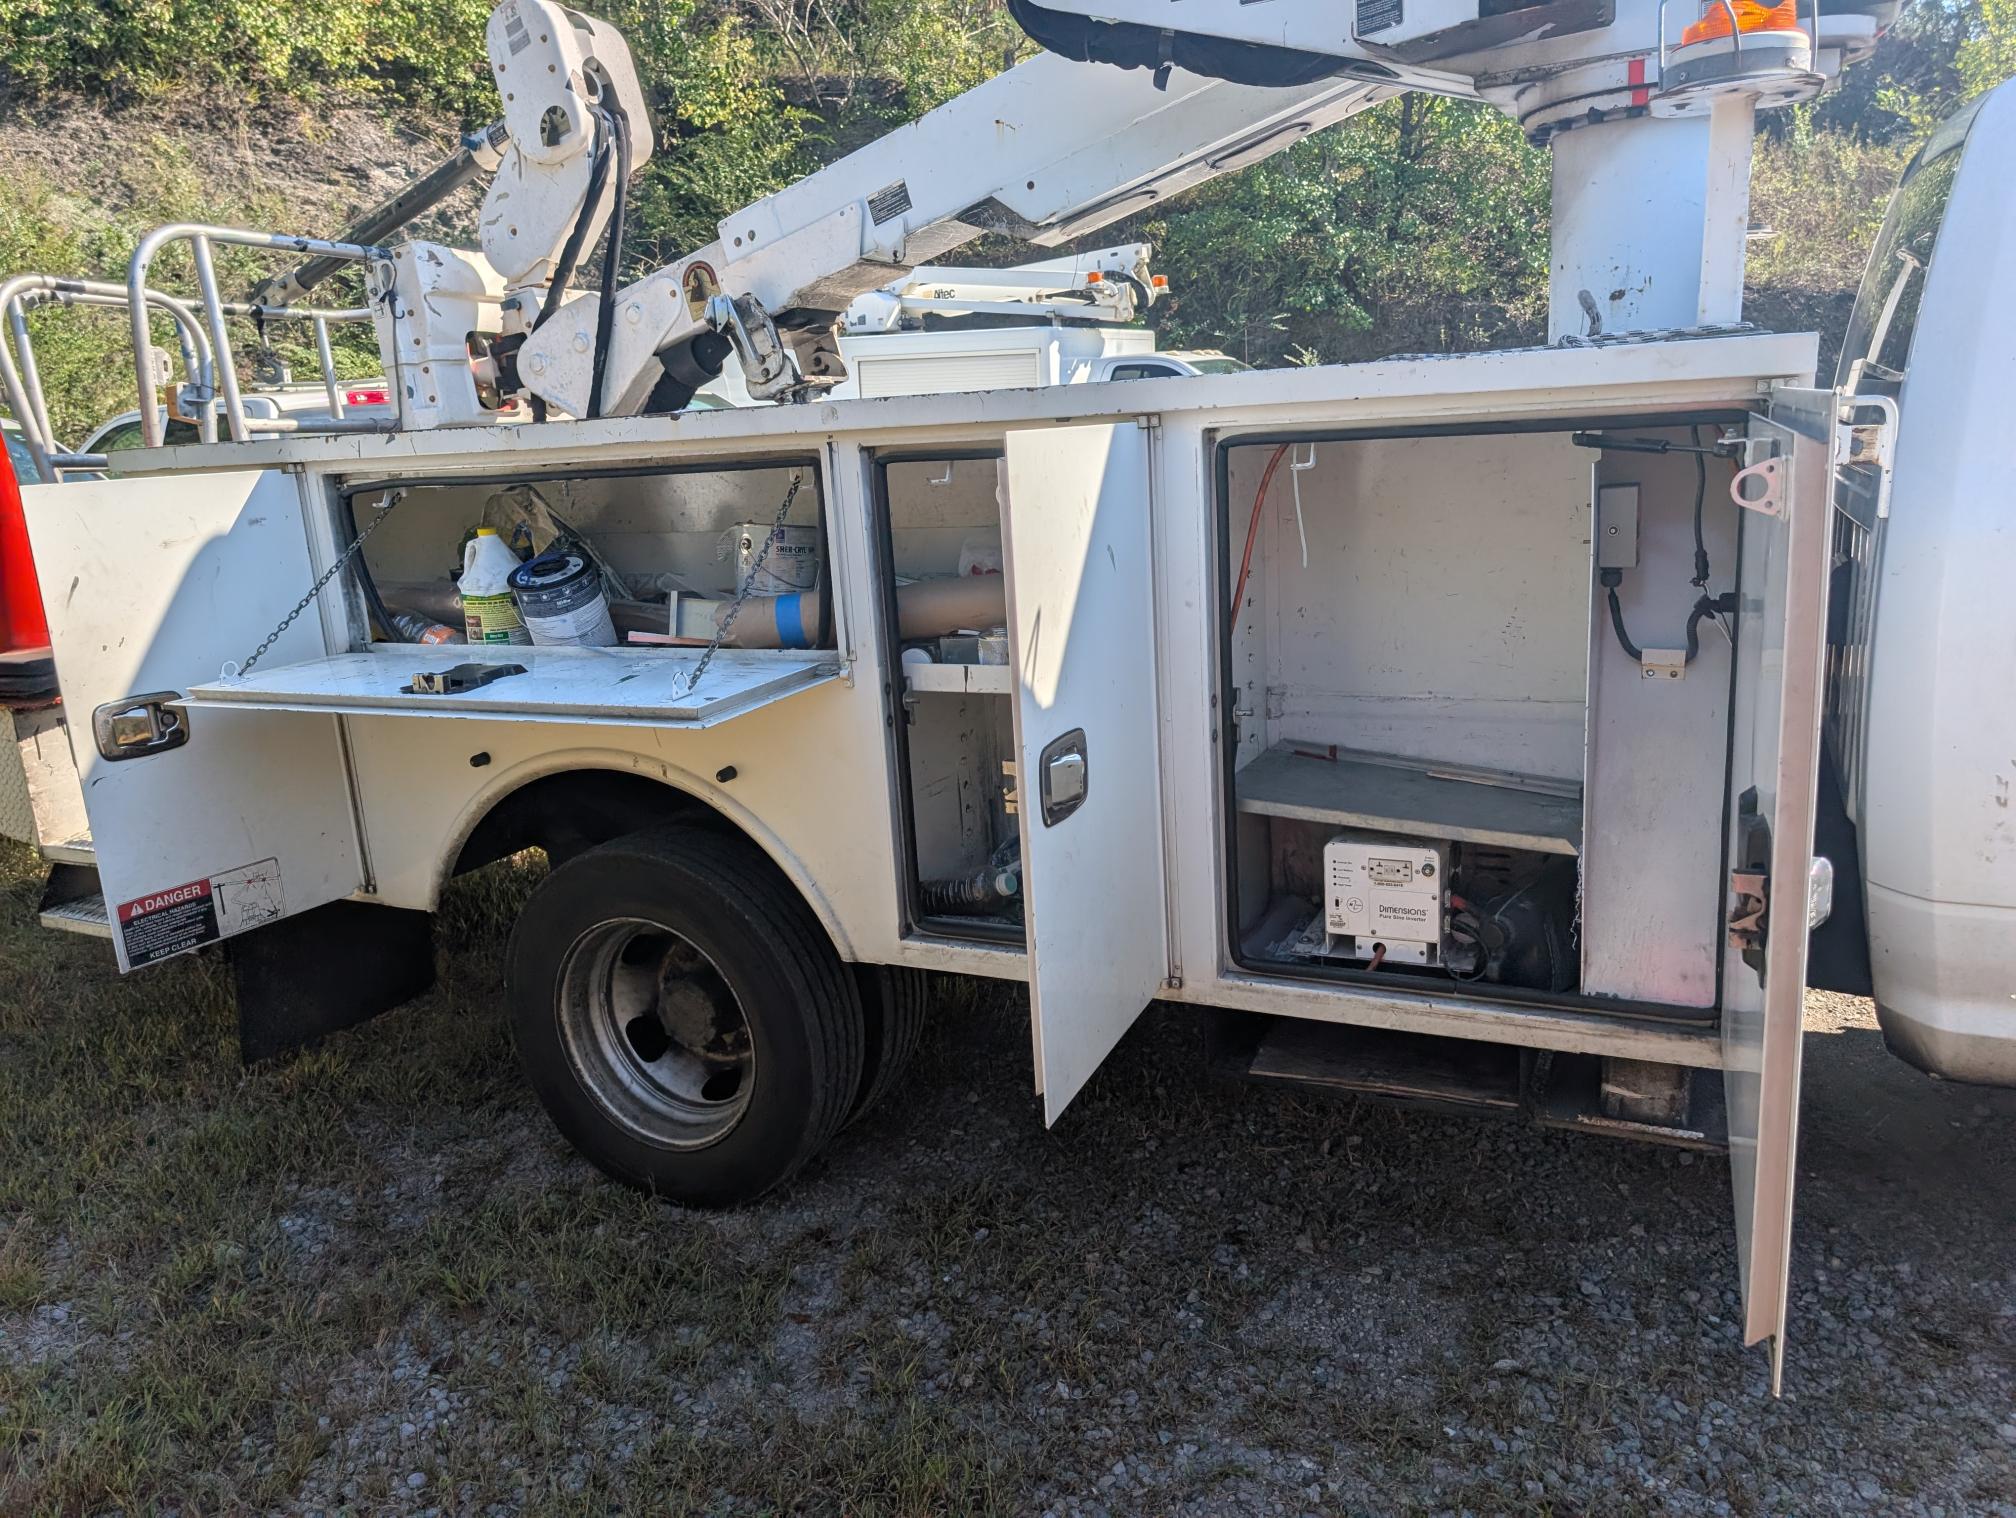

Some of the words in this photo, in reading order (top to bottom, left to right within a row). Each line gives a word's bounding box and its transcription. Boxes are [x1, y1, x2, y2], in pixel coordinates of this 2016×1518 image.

[145, 886, 201, 911] DANGER
[133, 911, 169, 926] ELECTRICAL
[169, 902, 197, 914] HAZARDS
[149, 948, 170, 959] KEEP
[171, 938, 197, 951] CLEAR
